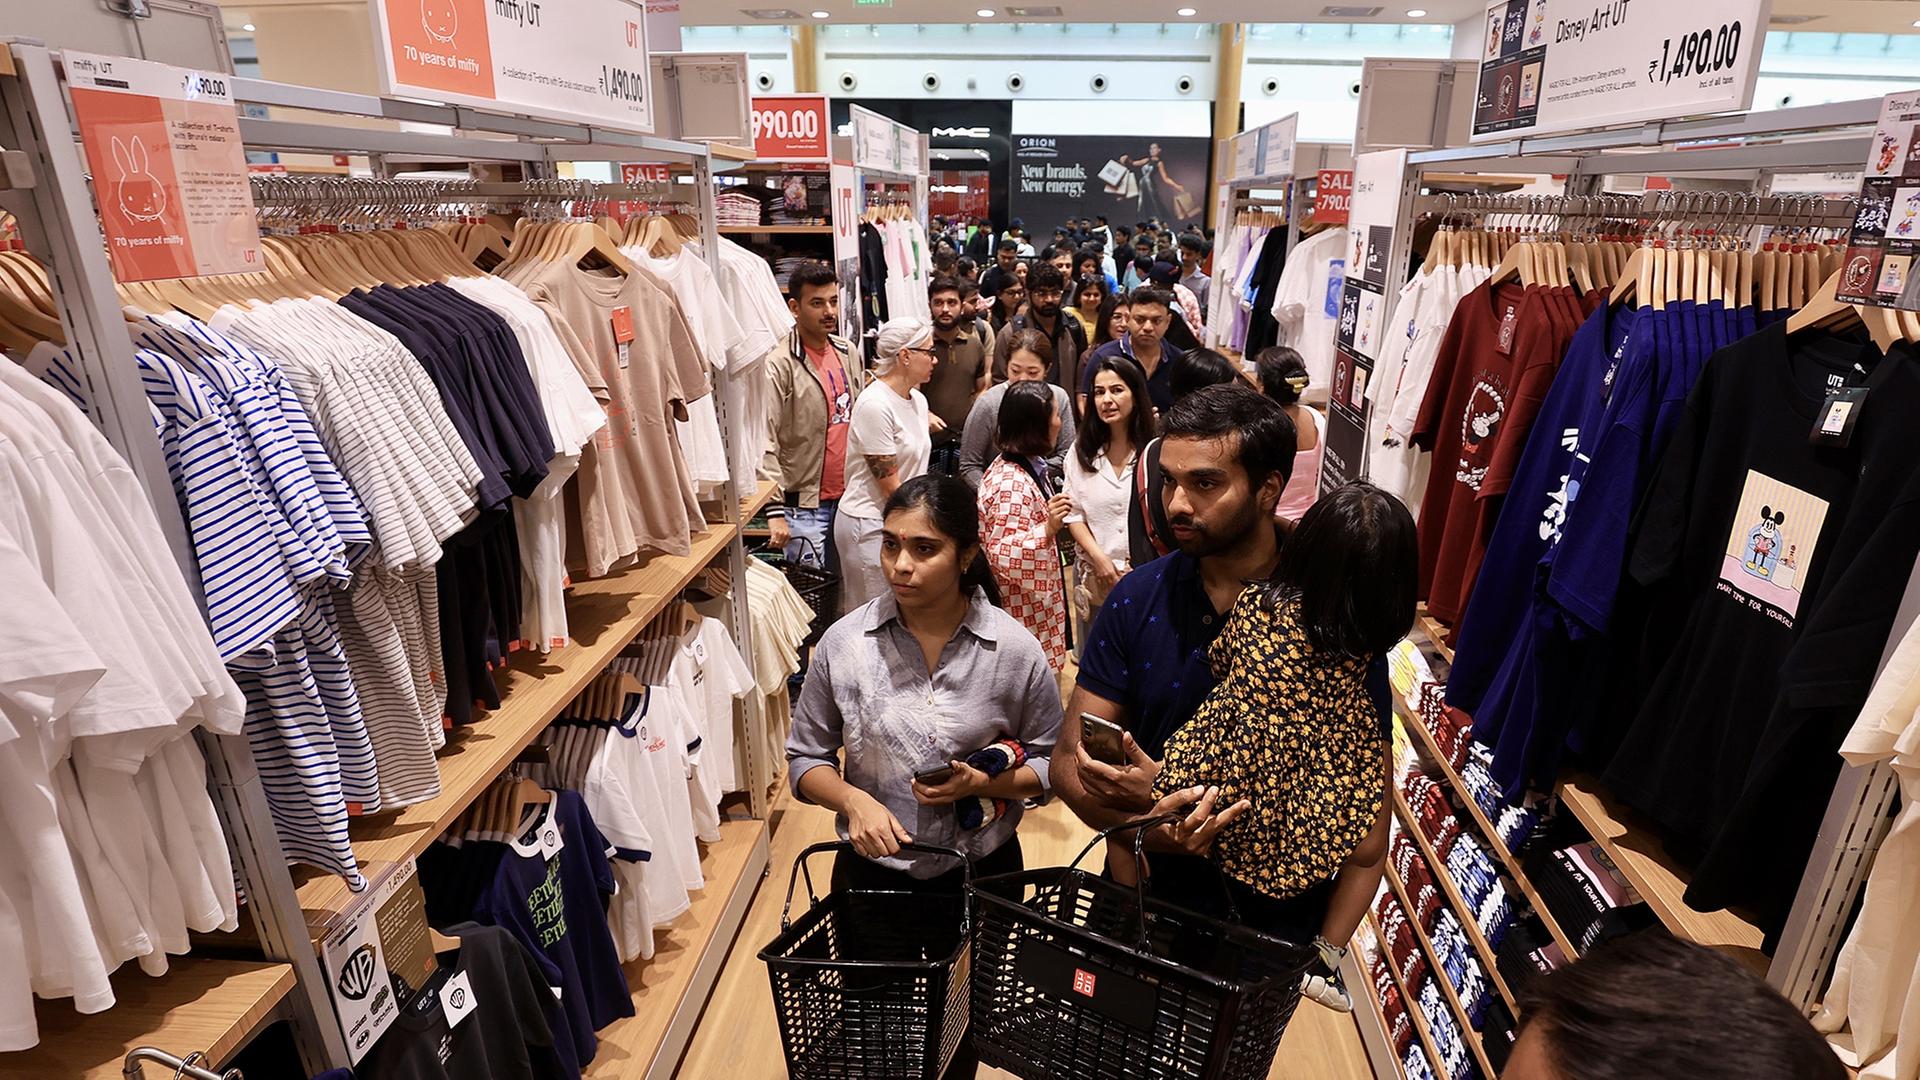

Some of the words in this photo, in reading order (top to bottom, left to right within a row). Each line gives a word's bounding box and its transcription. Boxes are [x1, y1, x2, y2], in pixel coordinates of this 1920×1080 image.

[495, 0, 525, 28] miffy
[526, 4, 541, 27] UT
[1556, 17, 1589, 44] Disney
[1589, 4, 1611, 34] Art
[1613, 0, 1631, 26] UT
[625, 20, 639, 49] UT
[403, 45, 417, 61] 70
[419, 51, 446, 66] years
[447, 55, 457, 69] of
[458, 58, 480, 76] miffy
[1648, 20, 1742, 87] ₹1,490.00
[73, 59, 97, 75] miffy
[99, 62, 113, 74] UT
[1889, 100, 1911, 112] Disney
[1020, 138, 1057, 147] ORION
[625, 167, 666, 183] SALE
[1021, 164, 1045, 178] New
[1046, 163, 1088, 179] brands.
[1020, 179, 1045, 192] New
[1046, 181, 1086, 198] energy.
[1321, 174, 1352, 190] SAL
[1316, 195, 1351, 210] ₹790.0
[838, 188, 852, 237] UT
[114, 236, 128, 247] 70
[128, 236, 153, 248] years
[153, 235, 162, 246] of
[163, 234, 184, 246] miffy
[244, 250, 256, 263] UT
[1748, 599, 1762, 612] FOR
[341, 948, 373, 995] WB
[423, 959, 433, 971] UT
[450, 988, 465, 1010] WB
